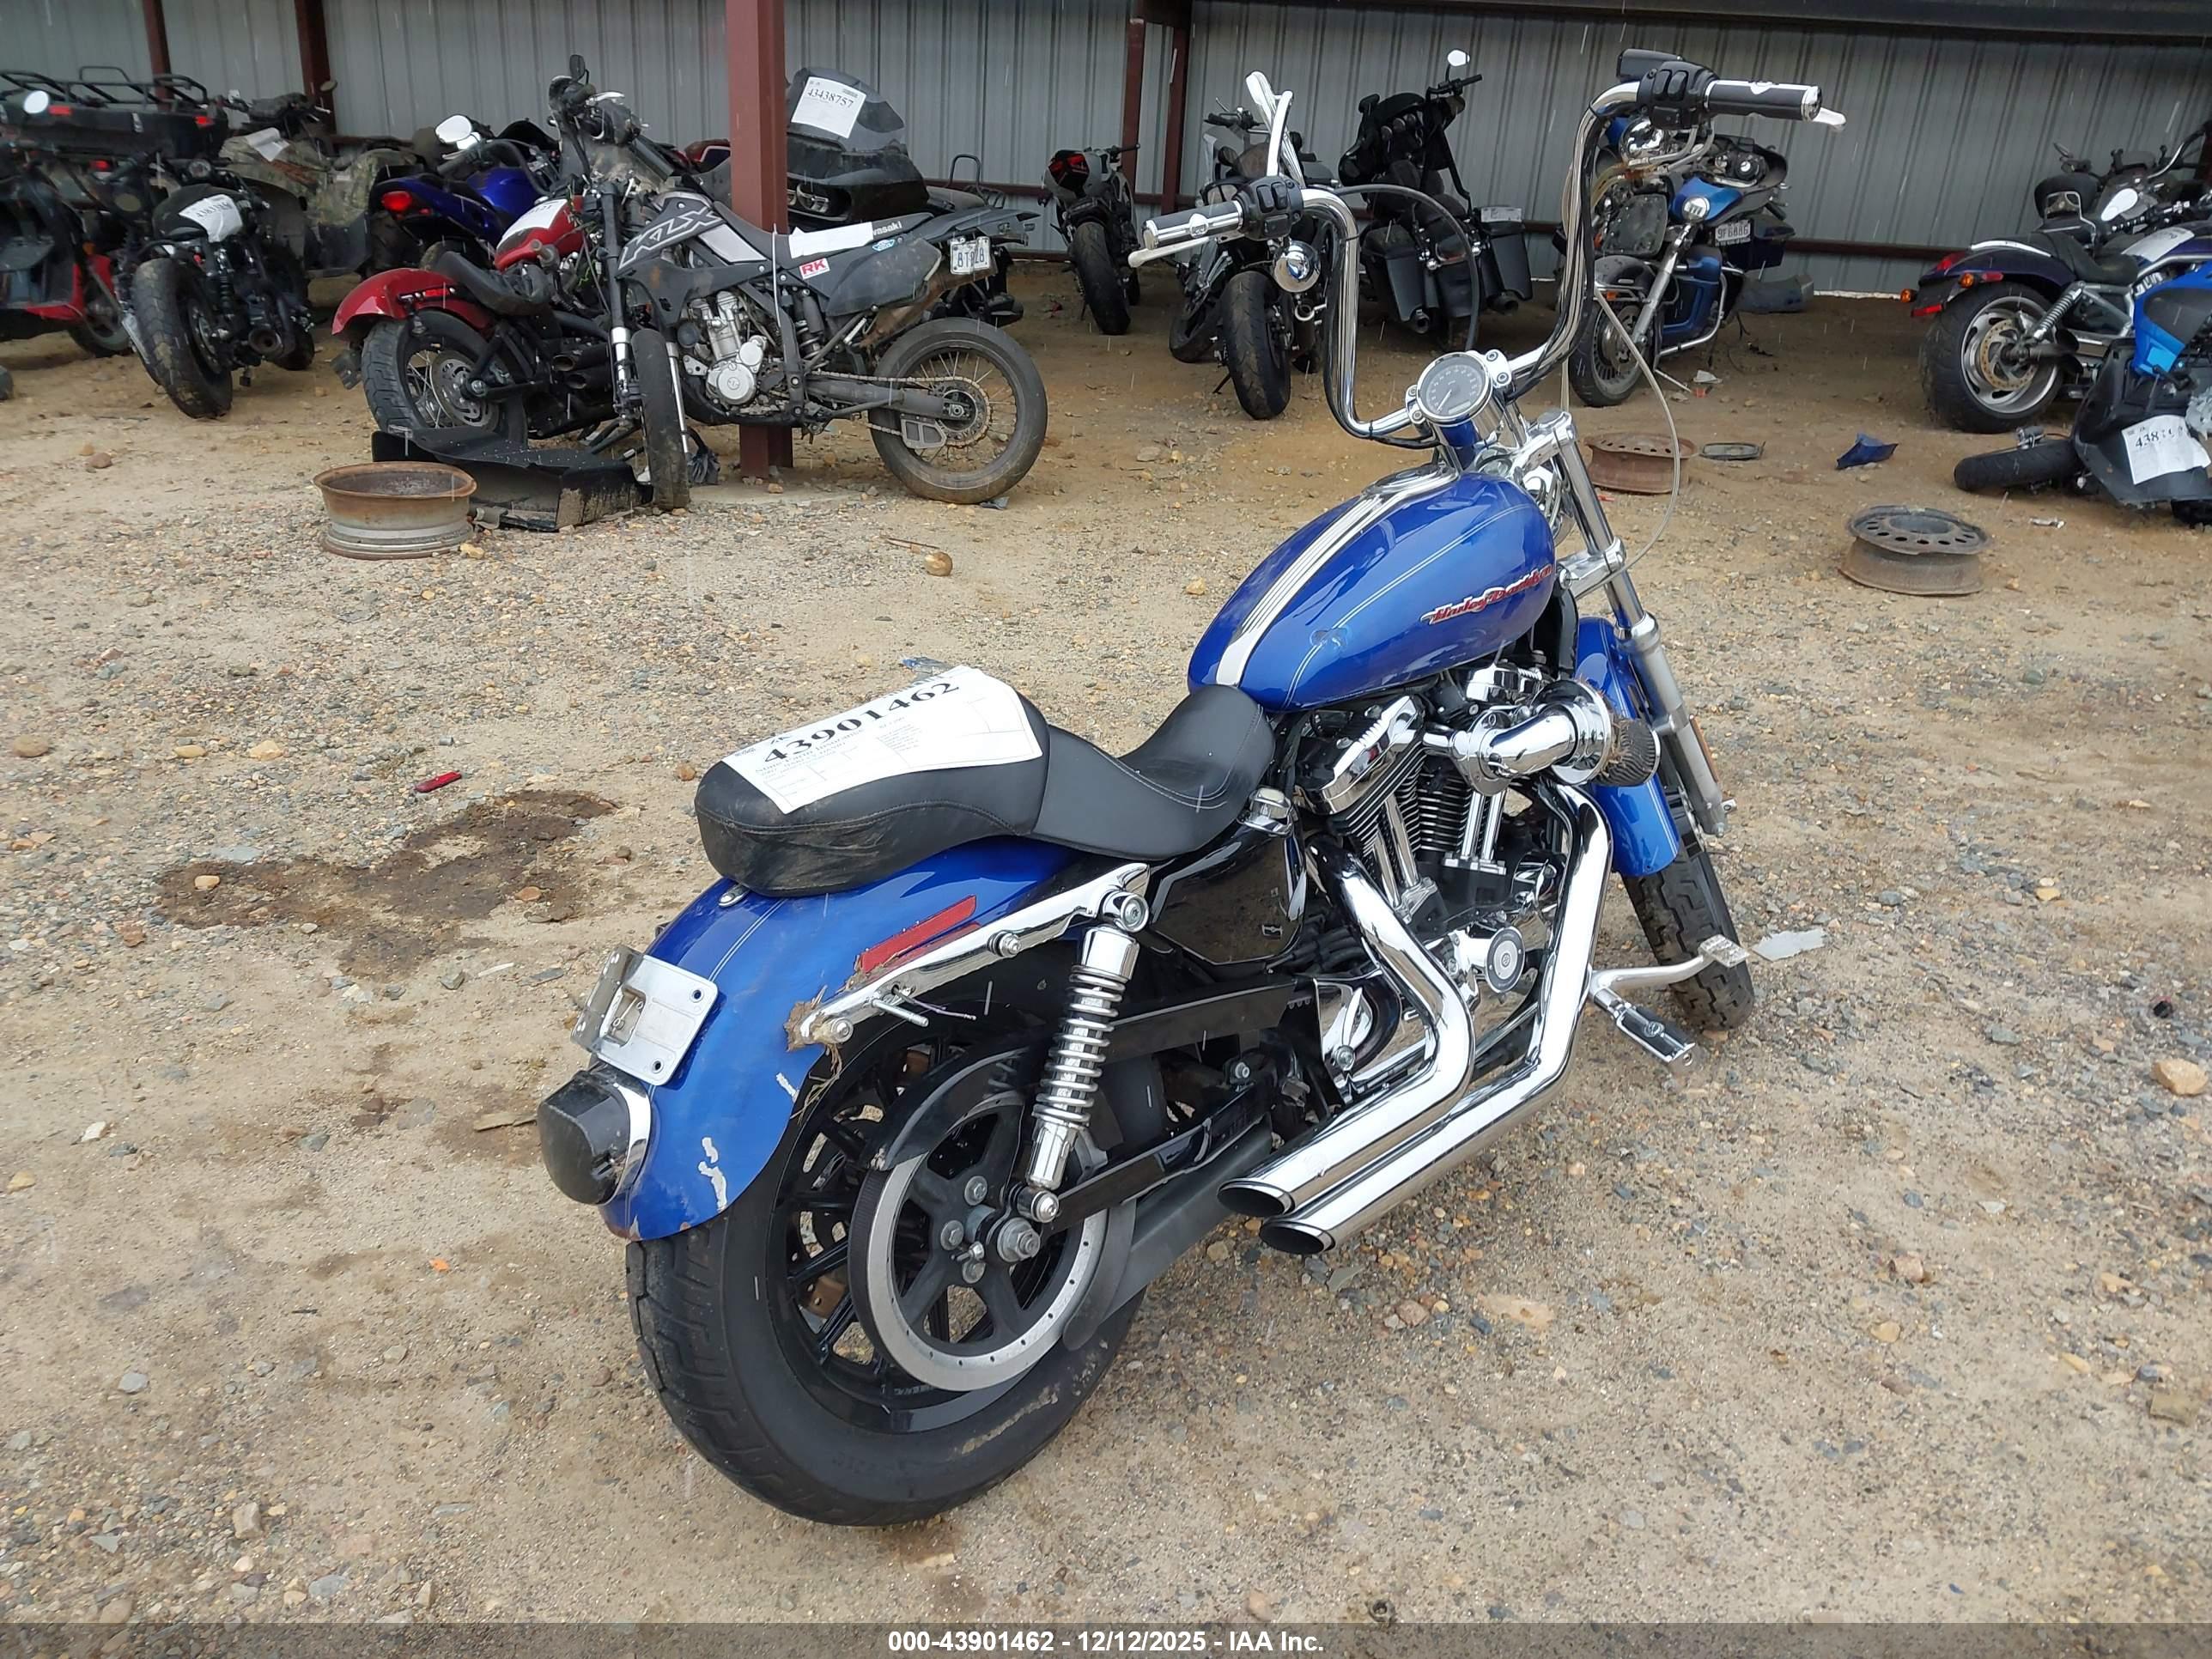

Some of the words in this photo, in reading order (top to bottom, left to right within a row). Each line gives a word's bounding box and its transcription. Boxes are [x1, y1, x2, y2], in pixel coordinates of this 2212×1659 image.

[807, 88, 854, 108] 43438757
[618, 207, 722, 270] KLX
[801, 259, 825, 275] RK
[764, 683, 960, 763] 43901462
